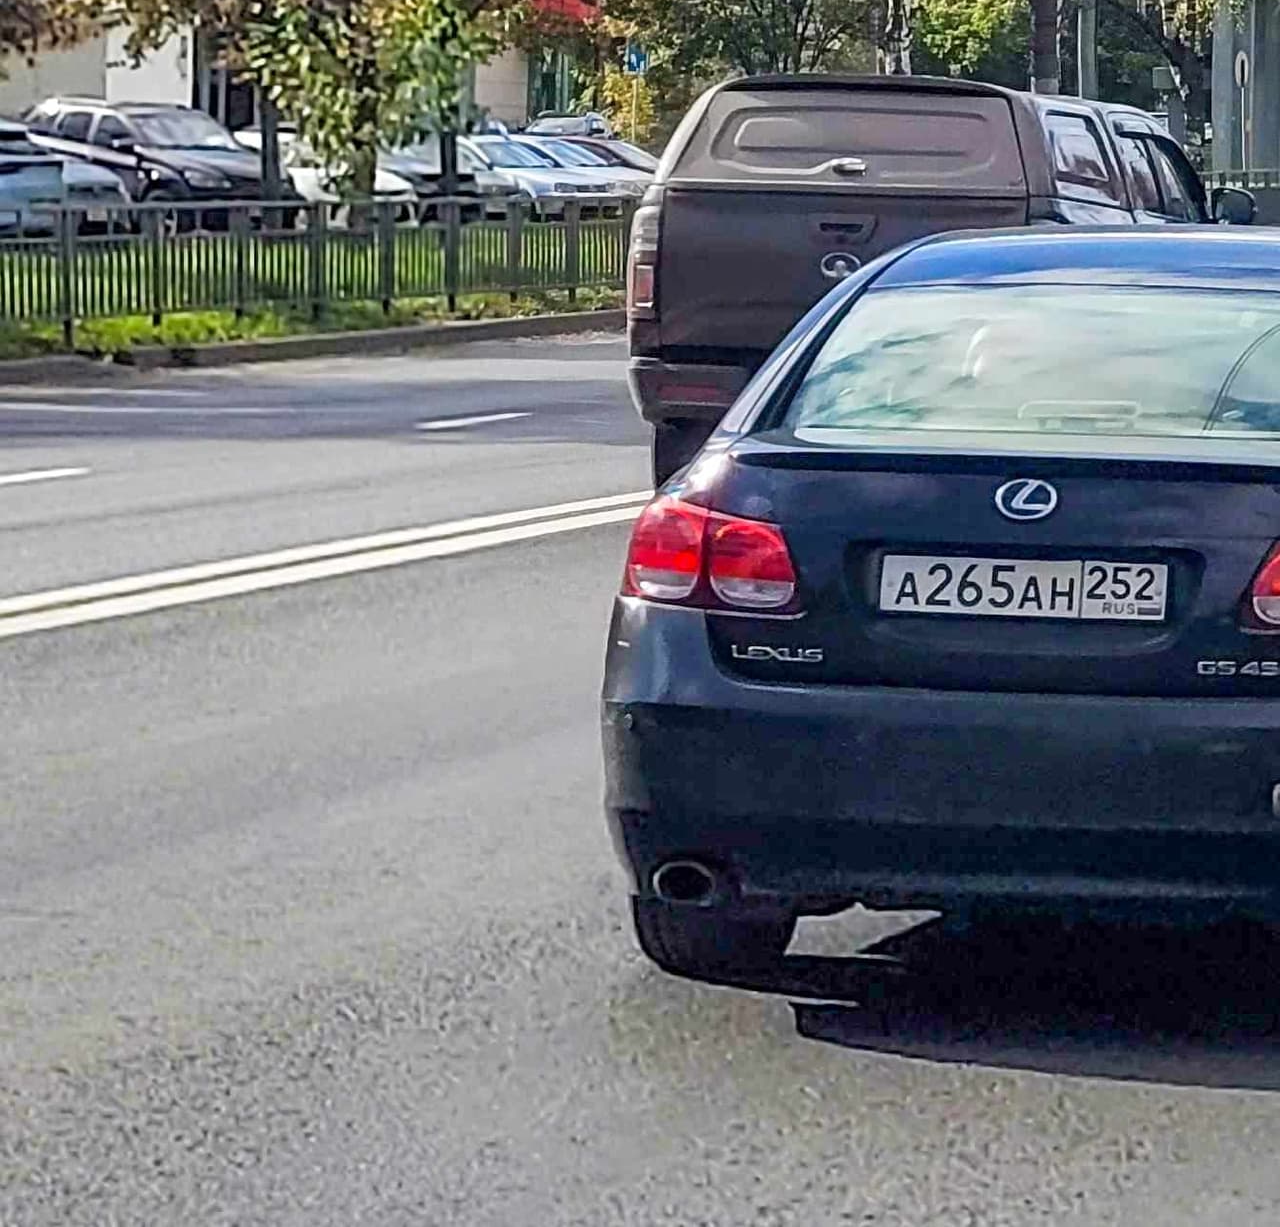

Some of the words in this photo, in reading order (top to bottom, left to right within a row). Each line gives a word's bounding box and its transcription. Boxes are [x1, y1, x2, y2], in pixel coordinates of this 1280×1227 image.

[895, 563, 1075, 611] А265АН
[1086, 565, 1155, 601] 252
[1101, 602, 1136, 616] RUS
[731, 644, 824, 663] LEXUS
